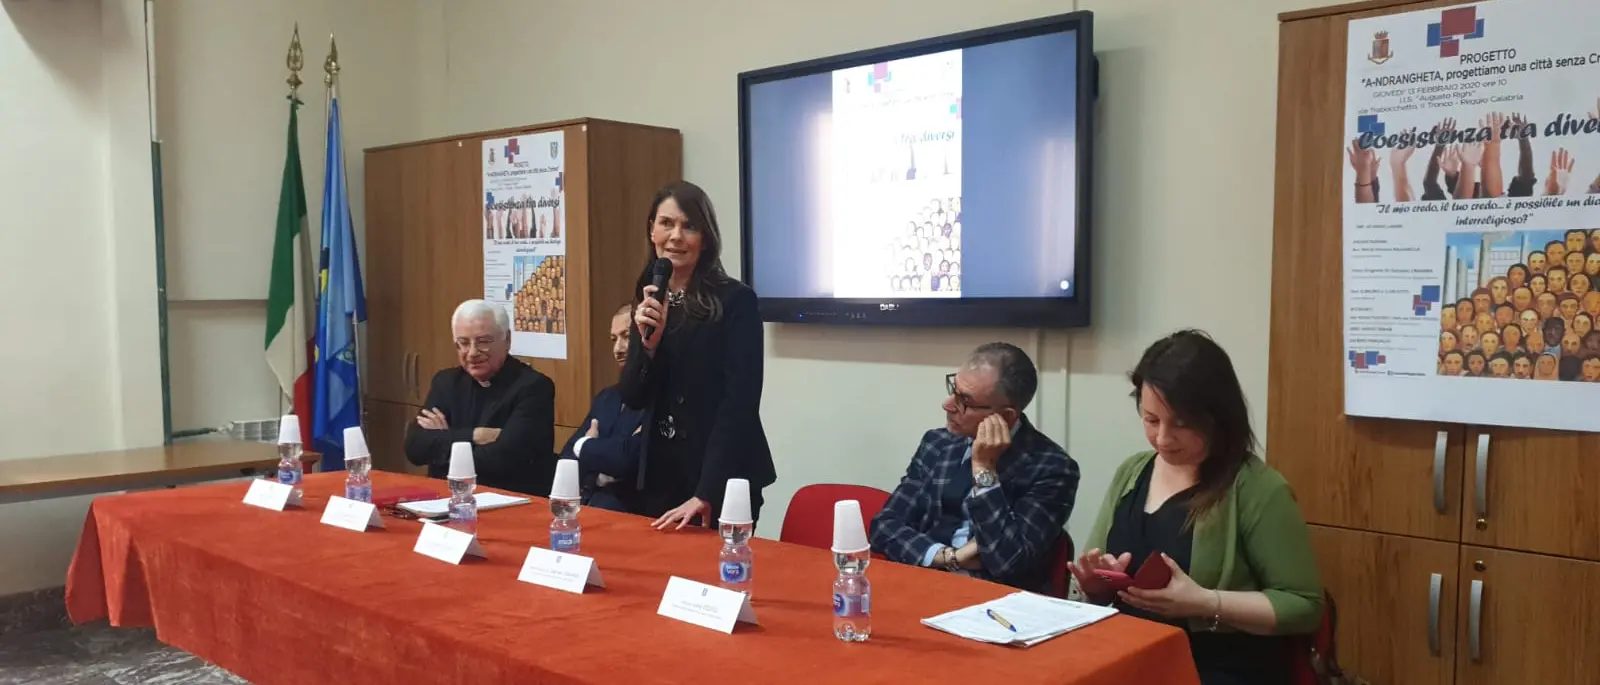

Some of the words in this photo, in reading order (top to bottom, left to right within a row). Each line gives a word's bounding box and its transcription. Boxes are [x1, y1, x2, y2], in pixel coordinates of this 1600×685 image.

[1460, 48, 1516, 65] PROGETTO
[1446, 64, 1506, 81] progettiamo
[1508, 62, 1527, 73] una
[1529, 58, 1553, 71] città
[1556, 56, 1586, 68] senza
[1416, 83, 1459, 94] FEBBRAIO
[1460, 81, 1481, 90] 2020
[1359, 126, 1491, 150] Coesistenza
[1500, 118, 1537, 139] tra
[1544, 112, 1600, 137] dive
[1452, 201, 1468, 211] tuo
[1514, 196, 1563, 211] possibile
[1566, 199, 1580, 207] un
